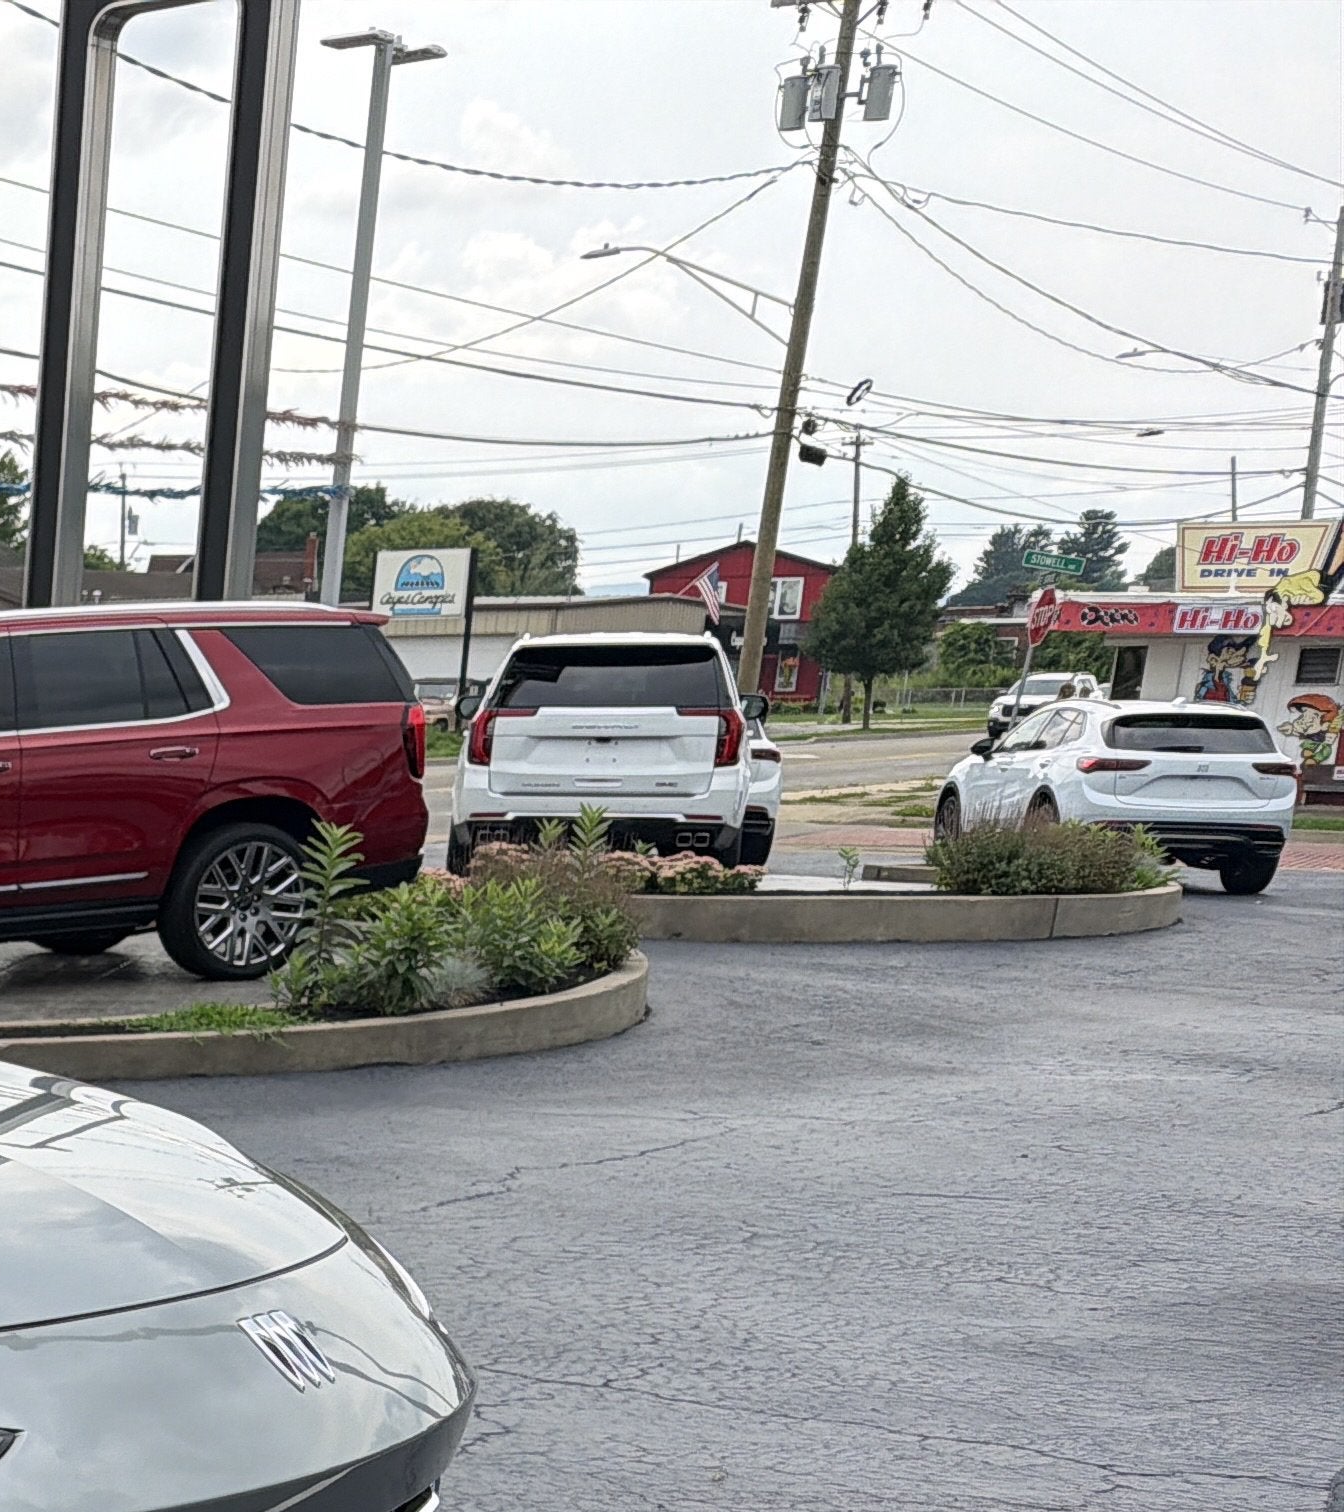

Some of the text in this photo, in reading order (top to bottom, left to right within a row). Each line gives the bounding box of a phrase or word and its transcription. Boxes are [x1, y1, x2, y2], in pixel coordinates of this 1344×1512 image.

[1199, 532, 1301, 565] Hi-Ho
[1031, 554, 1066, 568] STOWELL
[1200, 567, 1289, 578] DRIVE IN
[1032, 604, 1056, 629] STOP
[1177, 607, 1263, 631] Hi-Ho
